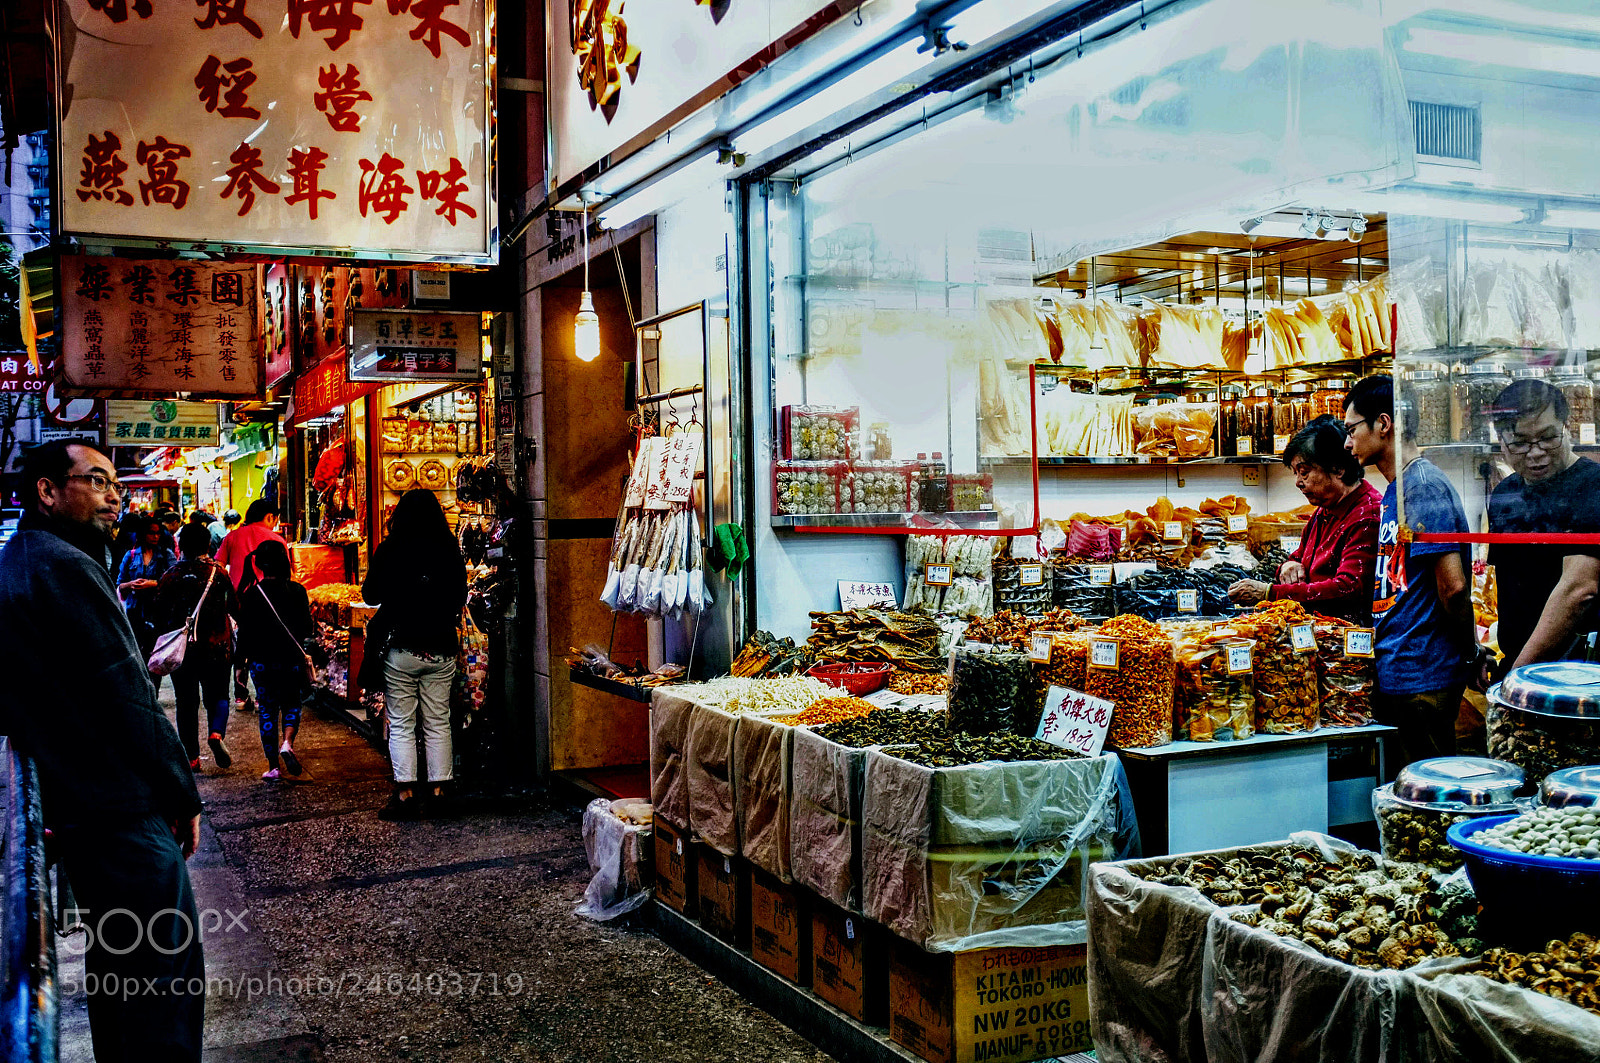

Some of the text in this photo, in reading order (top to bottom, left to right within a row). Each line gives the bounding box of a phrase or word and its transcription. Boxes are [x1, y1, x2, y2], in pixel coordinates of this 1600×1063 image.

[23, 380, 46, 390] CO
[976, 966, 1042, 991] KITAMI
[976, 981, 1045, 1006] TOKORO
[974, 1009, 1010, 1035] NW
[1014, 999, 1071, 1027] 20KG
